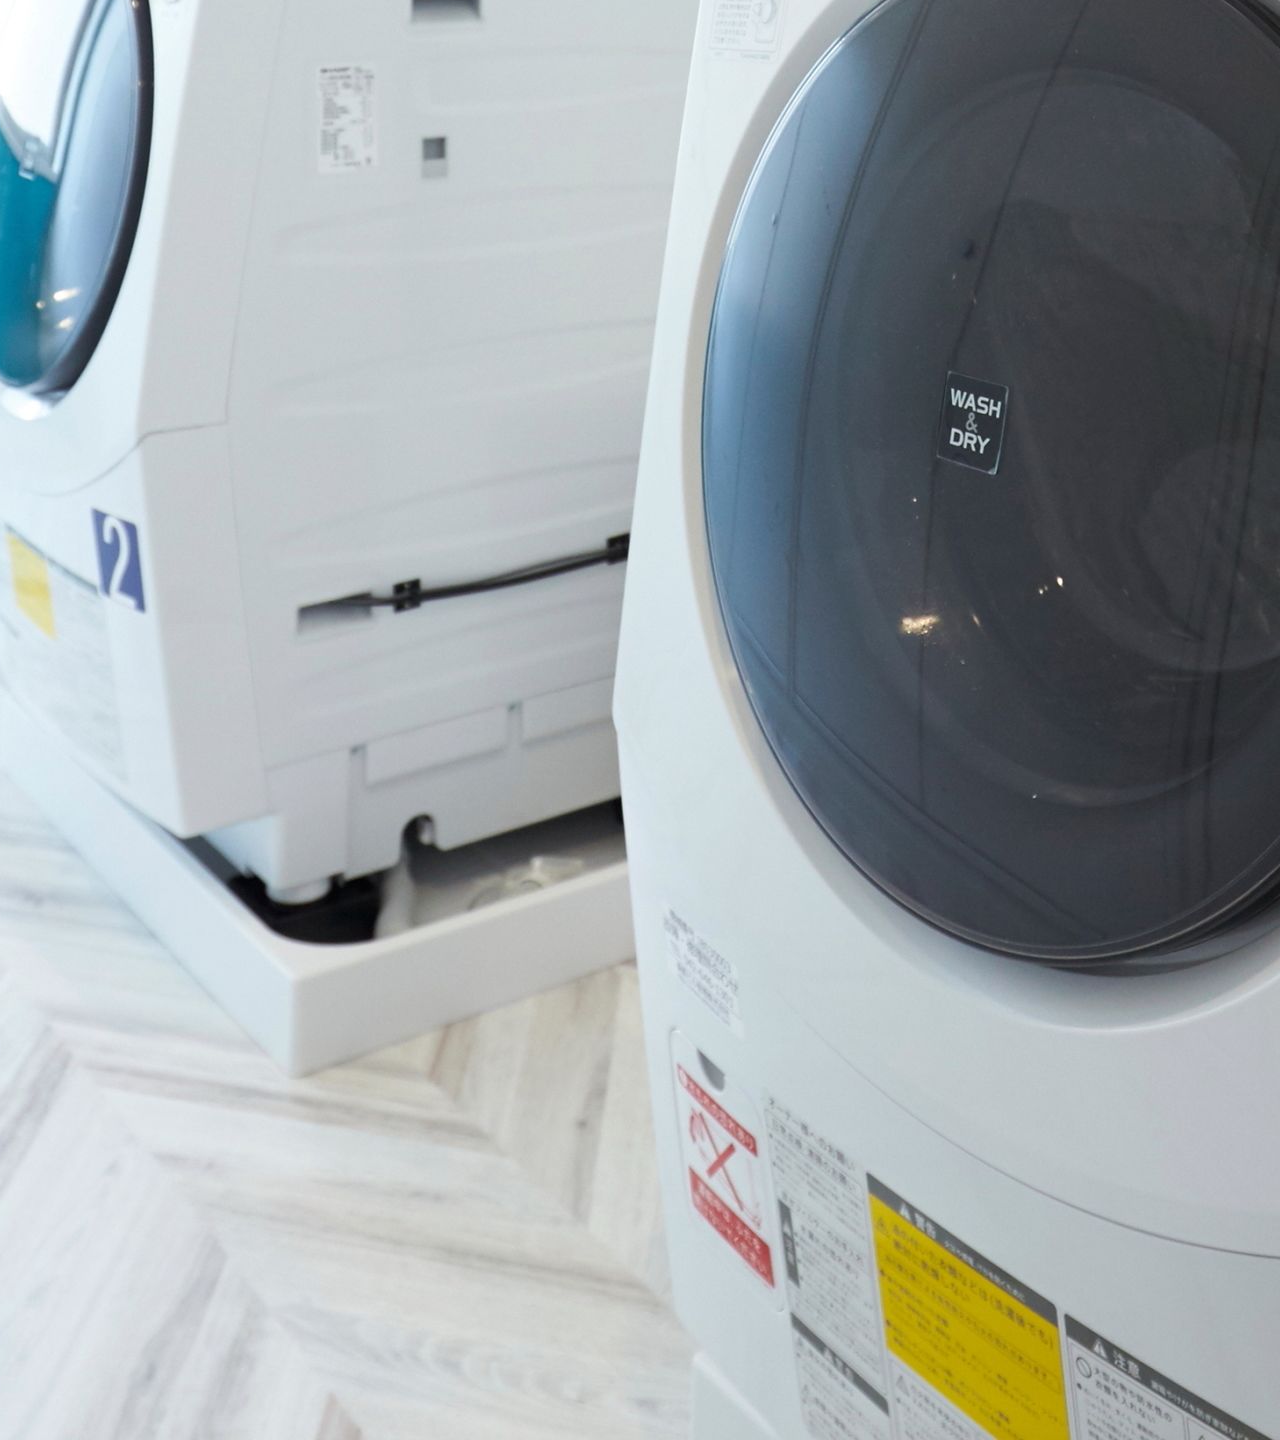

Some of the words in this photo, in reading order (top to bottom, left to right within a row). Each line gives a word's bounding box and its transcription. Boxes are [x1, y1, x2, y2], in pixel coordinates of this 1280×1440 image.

[950, 387, 1002, 419] WASH
[965, 412, 978, 433] &
[949, 427, 991, 454] DRY
[103, 514, 138, 610] 2
[1112, 1349, 1142, 1380] 注意
